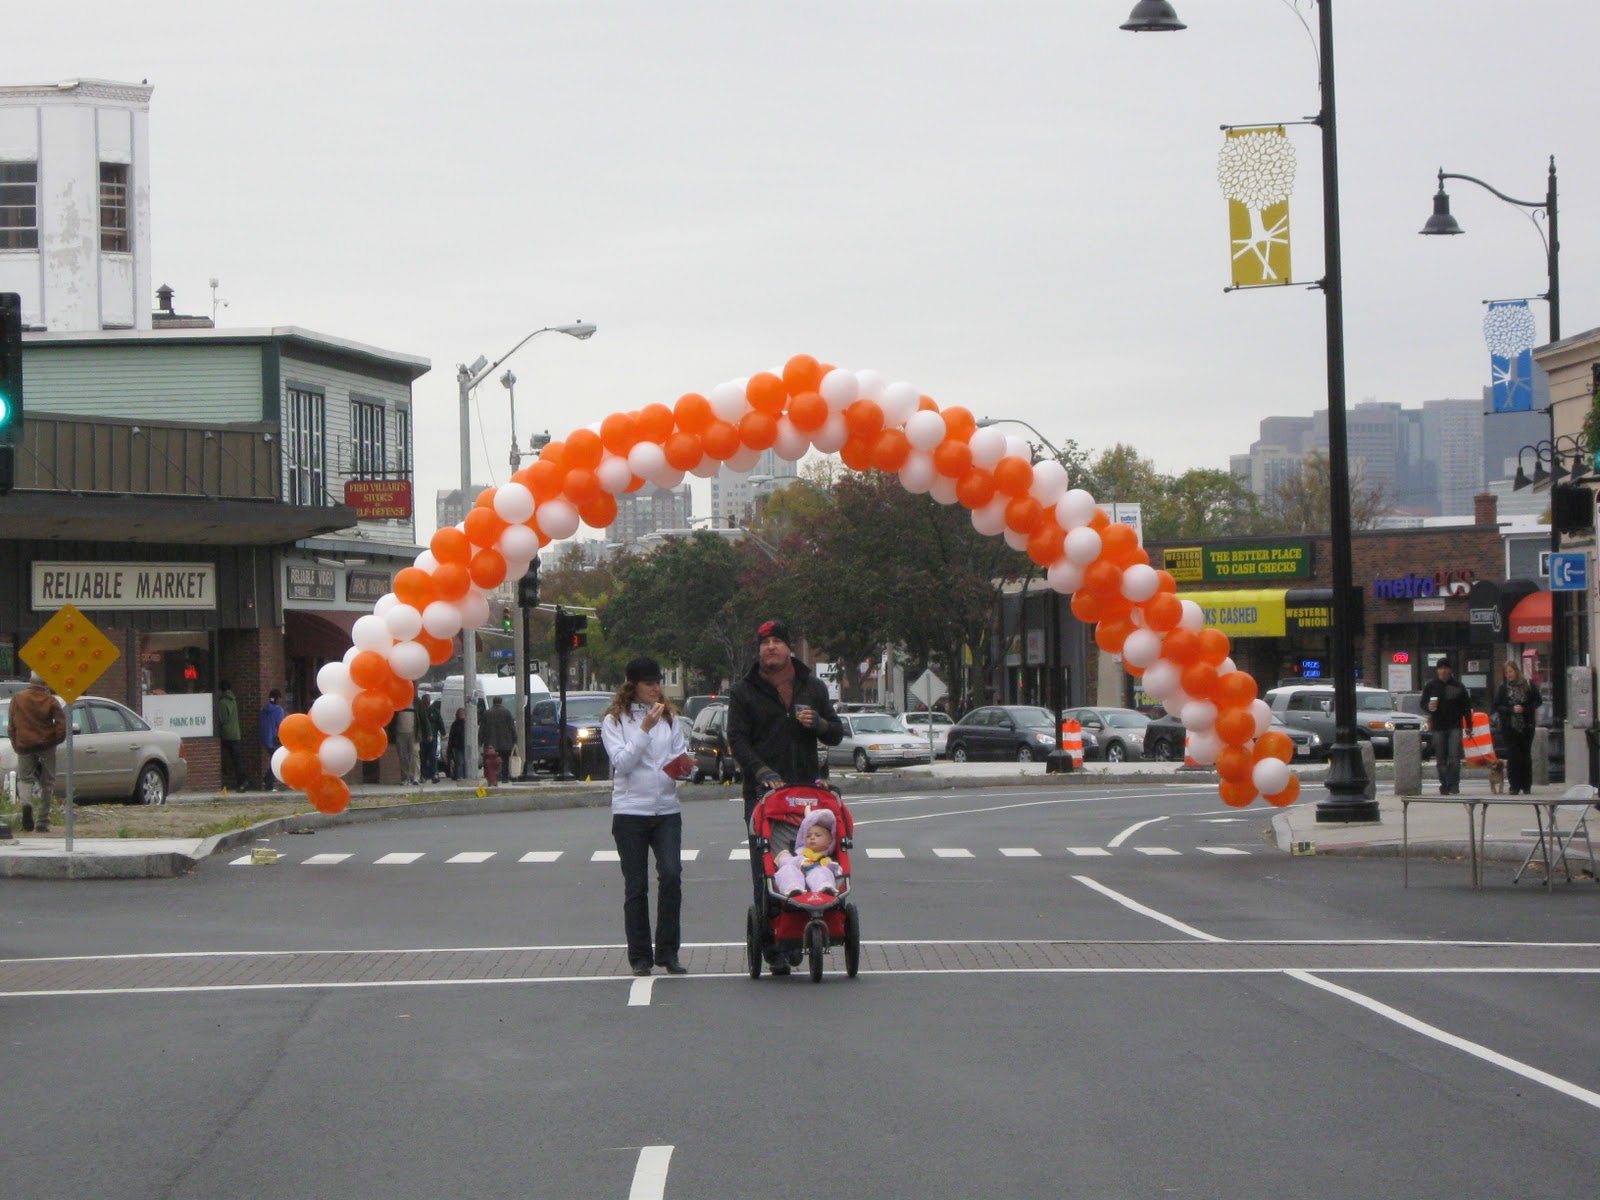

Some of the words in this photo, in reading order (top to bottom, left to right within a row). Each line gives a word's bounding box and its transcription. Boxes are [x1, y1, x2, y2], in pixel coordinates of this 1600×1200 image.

[349, 483, 369, 493] FRED
[356, 507, 405, 516] ELF-DEFENSE
[1165, 552, 1200, 561] WESTERN
[1210, 551, 1230, 562] THE
[1232, 550, 1269, 561] BETTER
[1271, 548, 1302, 560] PLACE
[1176, 560, 1200, 568] UNION
[1216, 564, 1229, 575] TO
[1232, 563, 1256, 574] CASH
[1257, 561, 1297, 573] CHECKS
[42, 572, 123, 599] RELIABLE
[136, 572, 206, 599] MARKET
[1220, 607, 1258, 625] CASHED
[1286, 608, 1328, 617] WESTERN
[1298, 617, 1328, 627] UNION
[1517, 625, 1552, 634] GROCERIE
[1392, 653, 1409, 663] OPEN
[169, 717, 188, 727] PARKING
[195, 716, 206, 726] REAR
